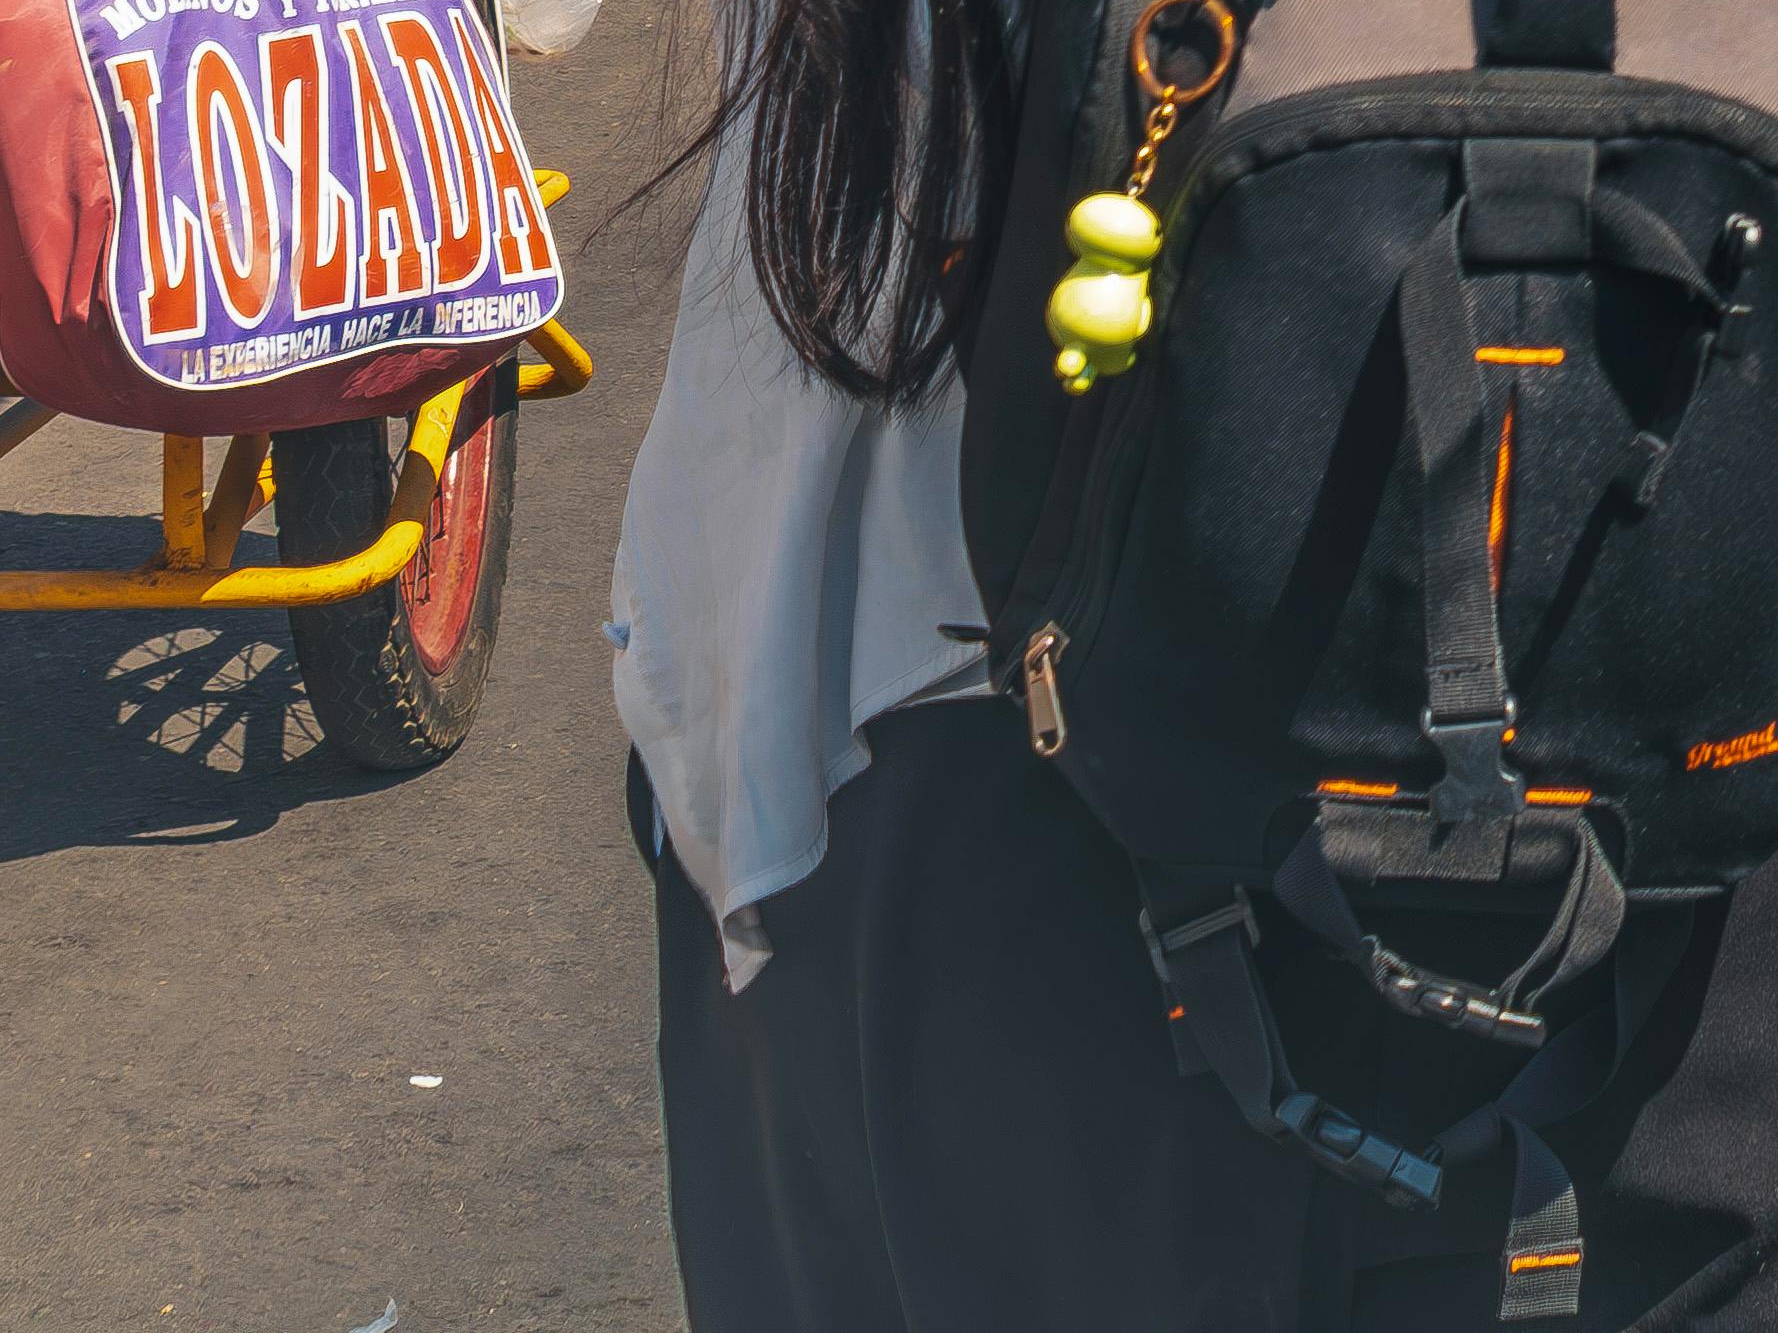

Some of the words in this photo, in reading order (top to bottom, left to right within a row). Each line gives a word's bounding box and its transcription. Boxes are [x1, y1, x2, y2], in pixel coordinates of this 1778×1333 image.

[105, 8, 556, 346] LOZADA
[181, 349, 205, 385] LA
[209, 331, 333, 381] EXPERIENCIA
[340, 313, 394, 353] HACE
[397, 306, 424, 337] LA
[431, 289, 543, 336] DIFERENCIA
